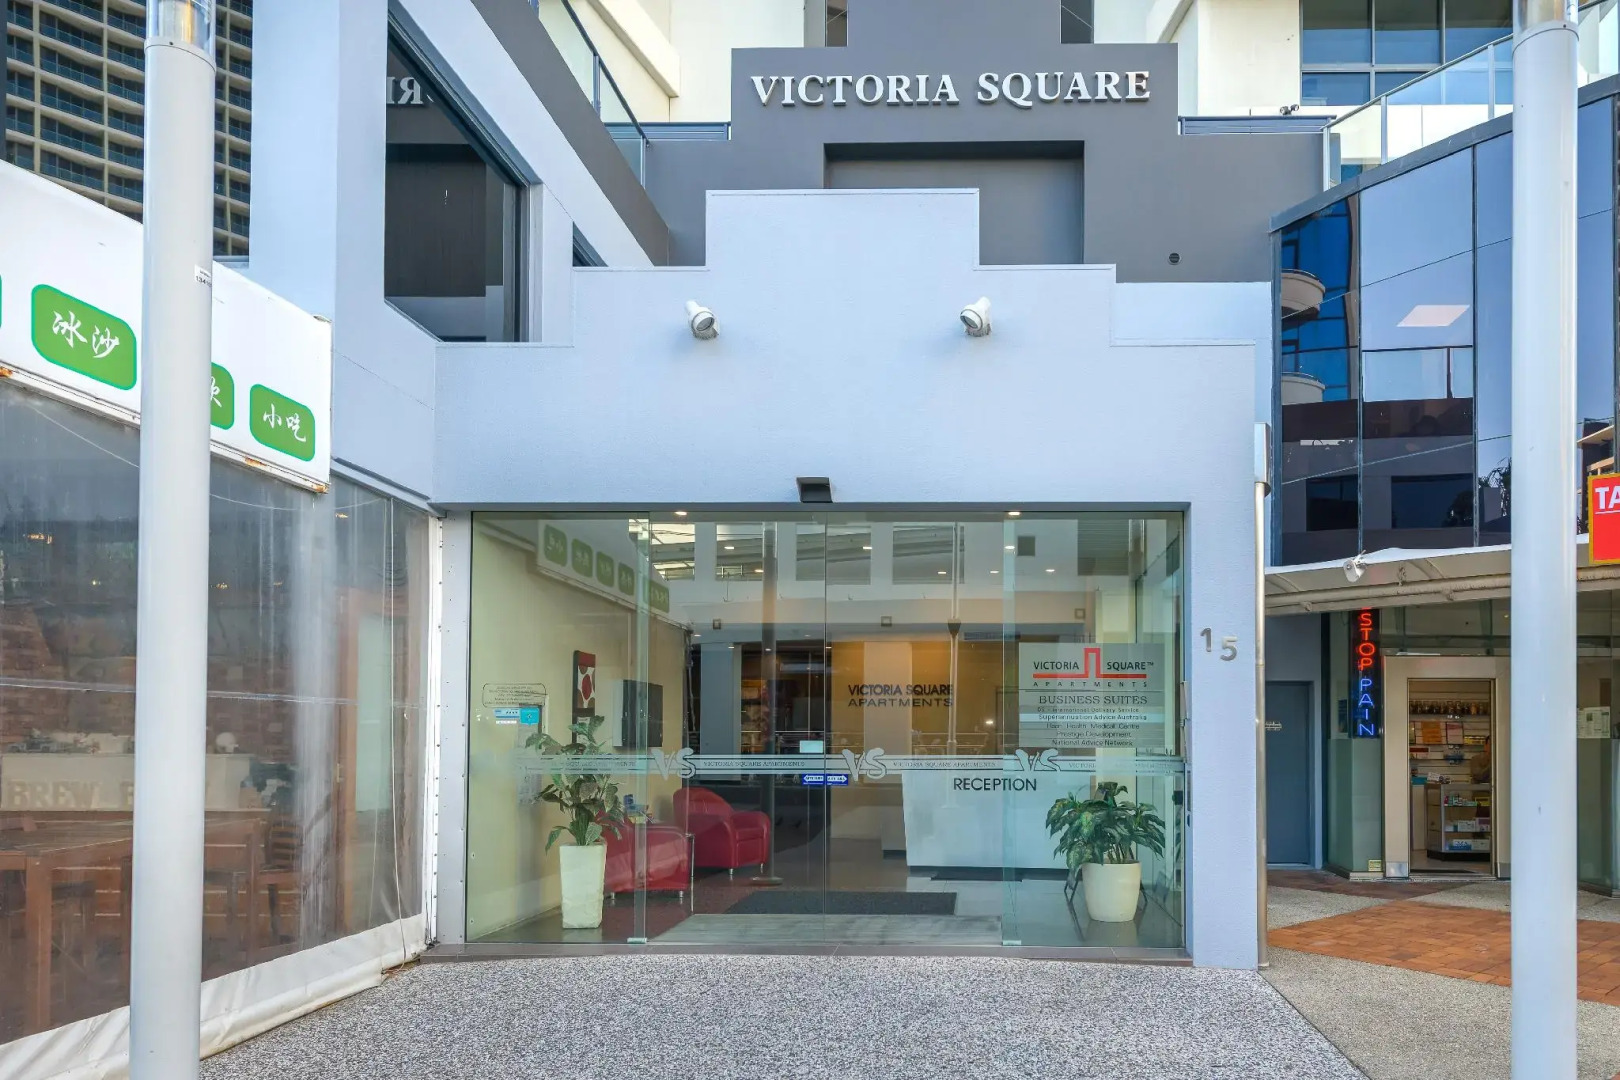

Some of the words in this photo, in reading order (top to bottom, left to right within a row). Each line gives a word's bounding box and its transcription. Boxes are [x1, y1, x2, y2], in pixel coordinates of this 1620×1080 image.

[750, 74, 960, 107] VICTORIA
[977, 70, 1151, 109] SQUARE
[52, 310, 120, 359] 冰沙
[262, 403, 306, 443] 小吃
[1359, 612, 1376, 671] STOP
[1033, 661, 1080, 670] VICTORIA
[848, 684, 903, 696] VICTORIA
[906, 684, 954, 696] SQUARE
[848, 698, 954, 707] APARTMENTS
[1039, 695, 1100, 704] BUSINESS
[1103, 695, 1148, 704] SUITES
[1358, 678, 1375, 736] PAIN
[953, 778, 1037, 791] RECEPTION
